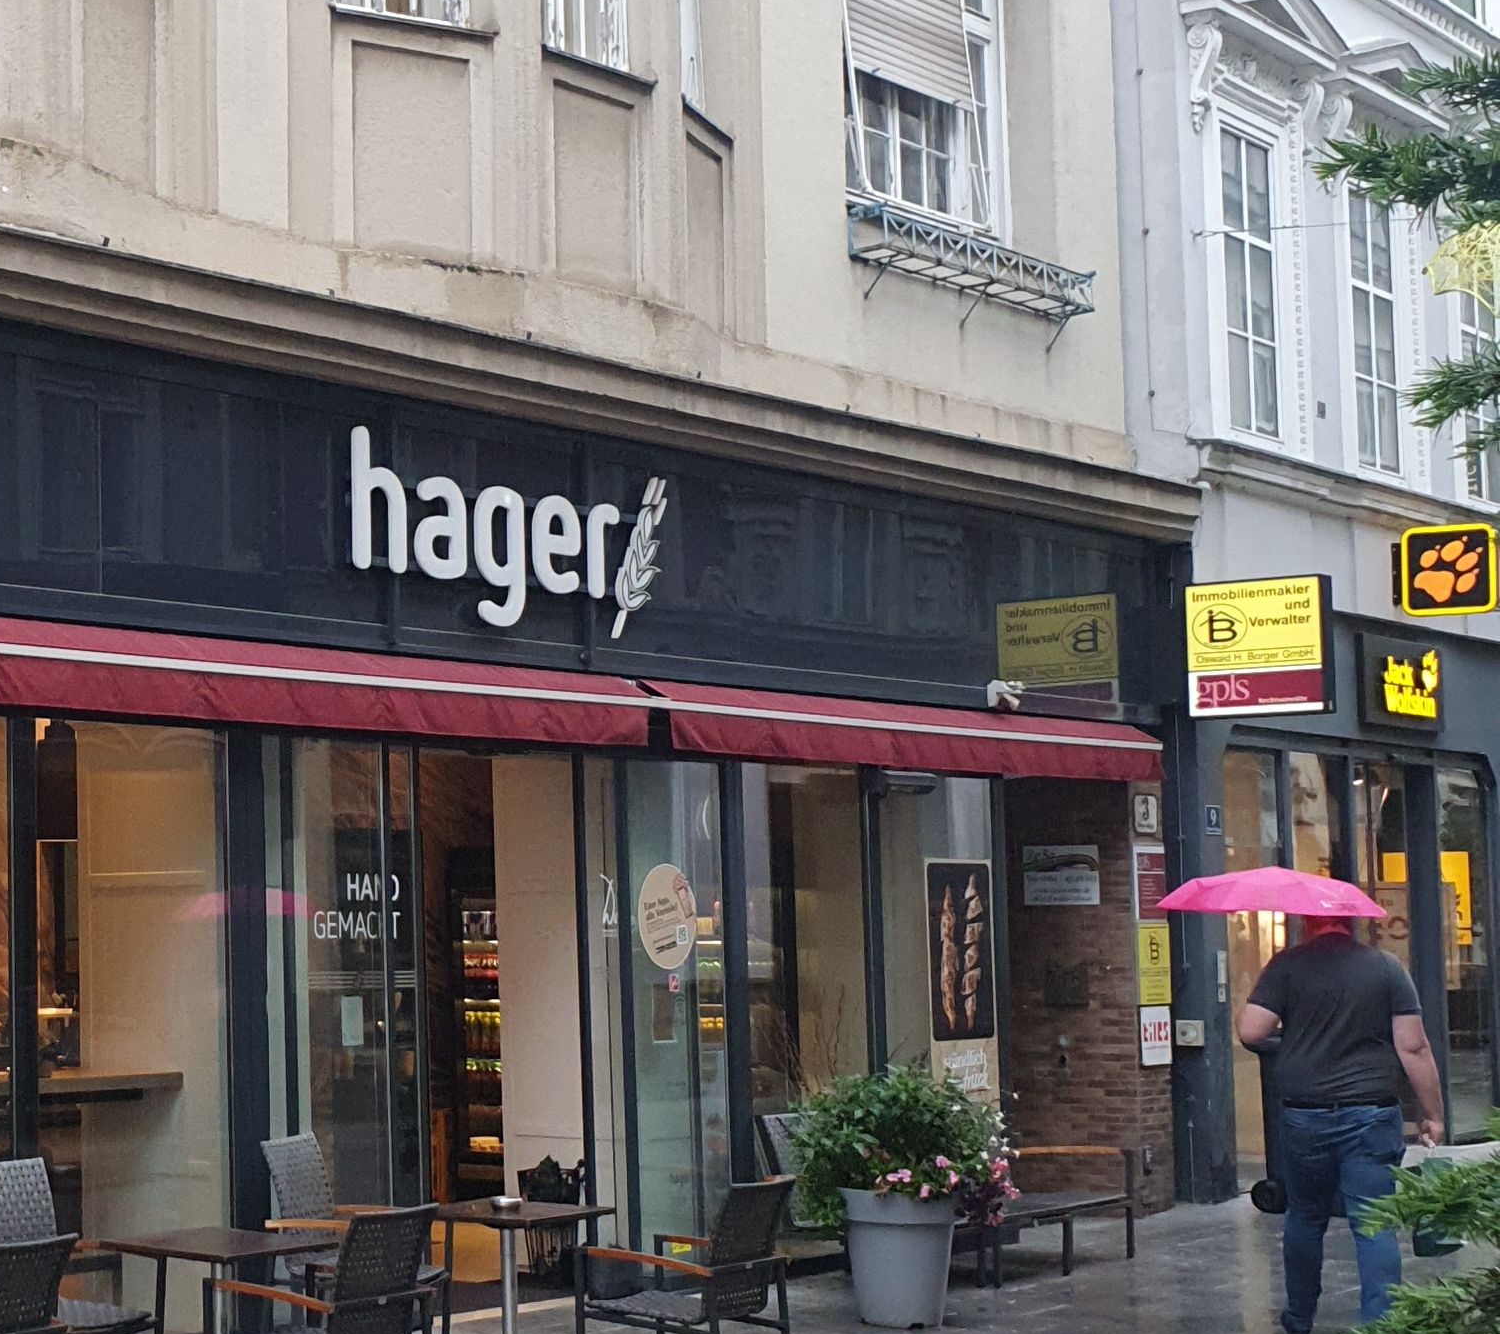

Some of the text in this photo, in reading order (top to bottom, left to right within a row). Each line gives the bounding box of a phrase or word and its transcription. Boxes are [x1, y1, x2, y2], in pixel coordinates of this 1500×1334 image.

[349, 424, 621, 628] hager
[1191, 584, 1311, 604] Immobilienmakler
[1284, 598, 1311, 611] und
[1249, 614, 1312, 628] Verwalter
[1383, 655, 1415, 687] Jack
[1384, 683, 1437, 718] Wolfskin
[1141, 796, 1150, 821] 3
[1210, 809, 1217, 826] 9
